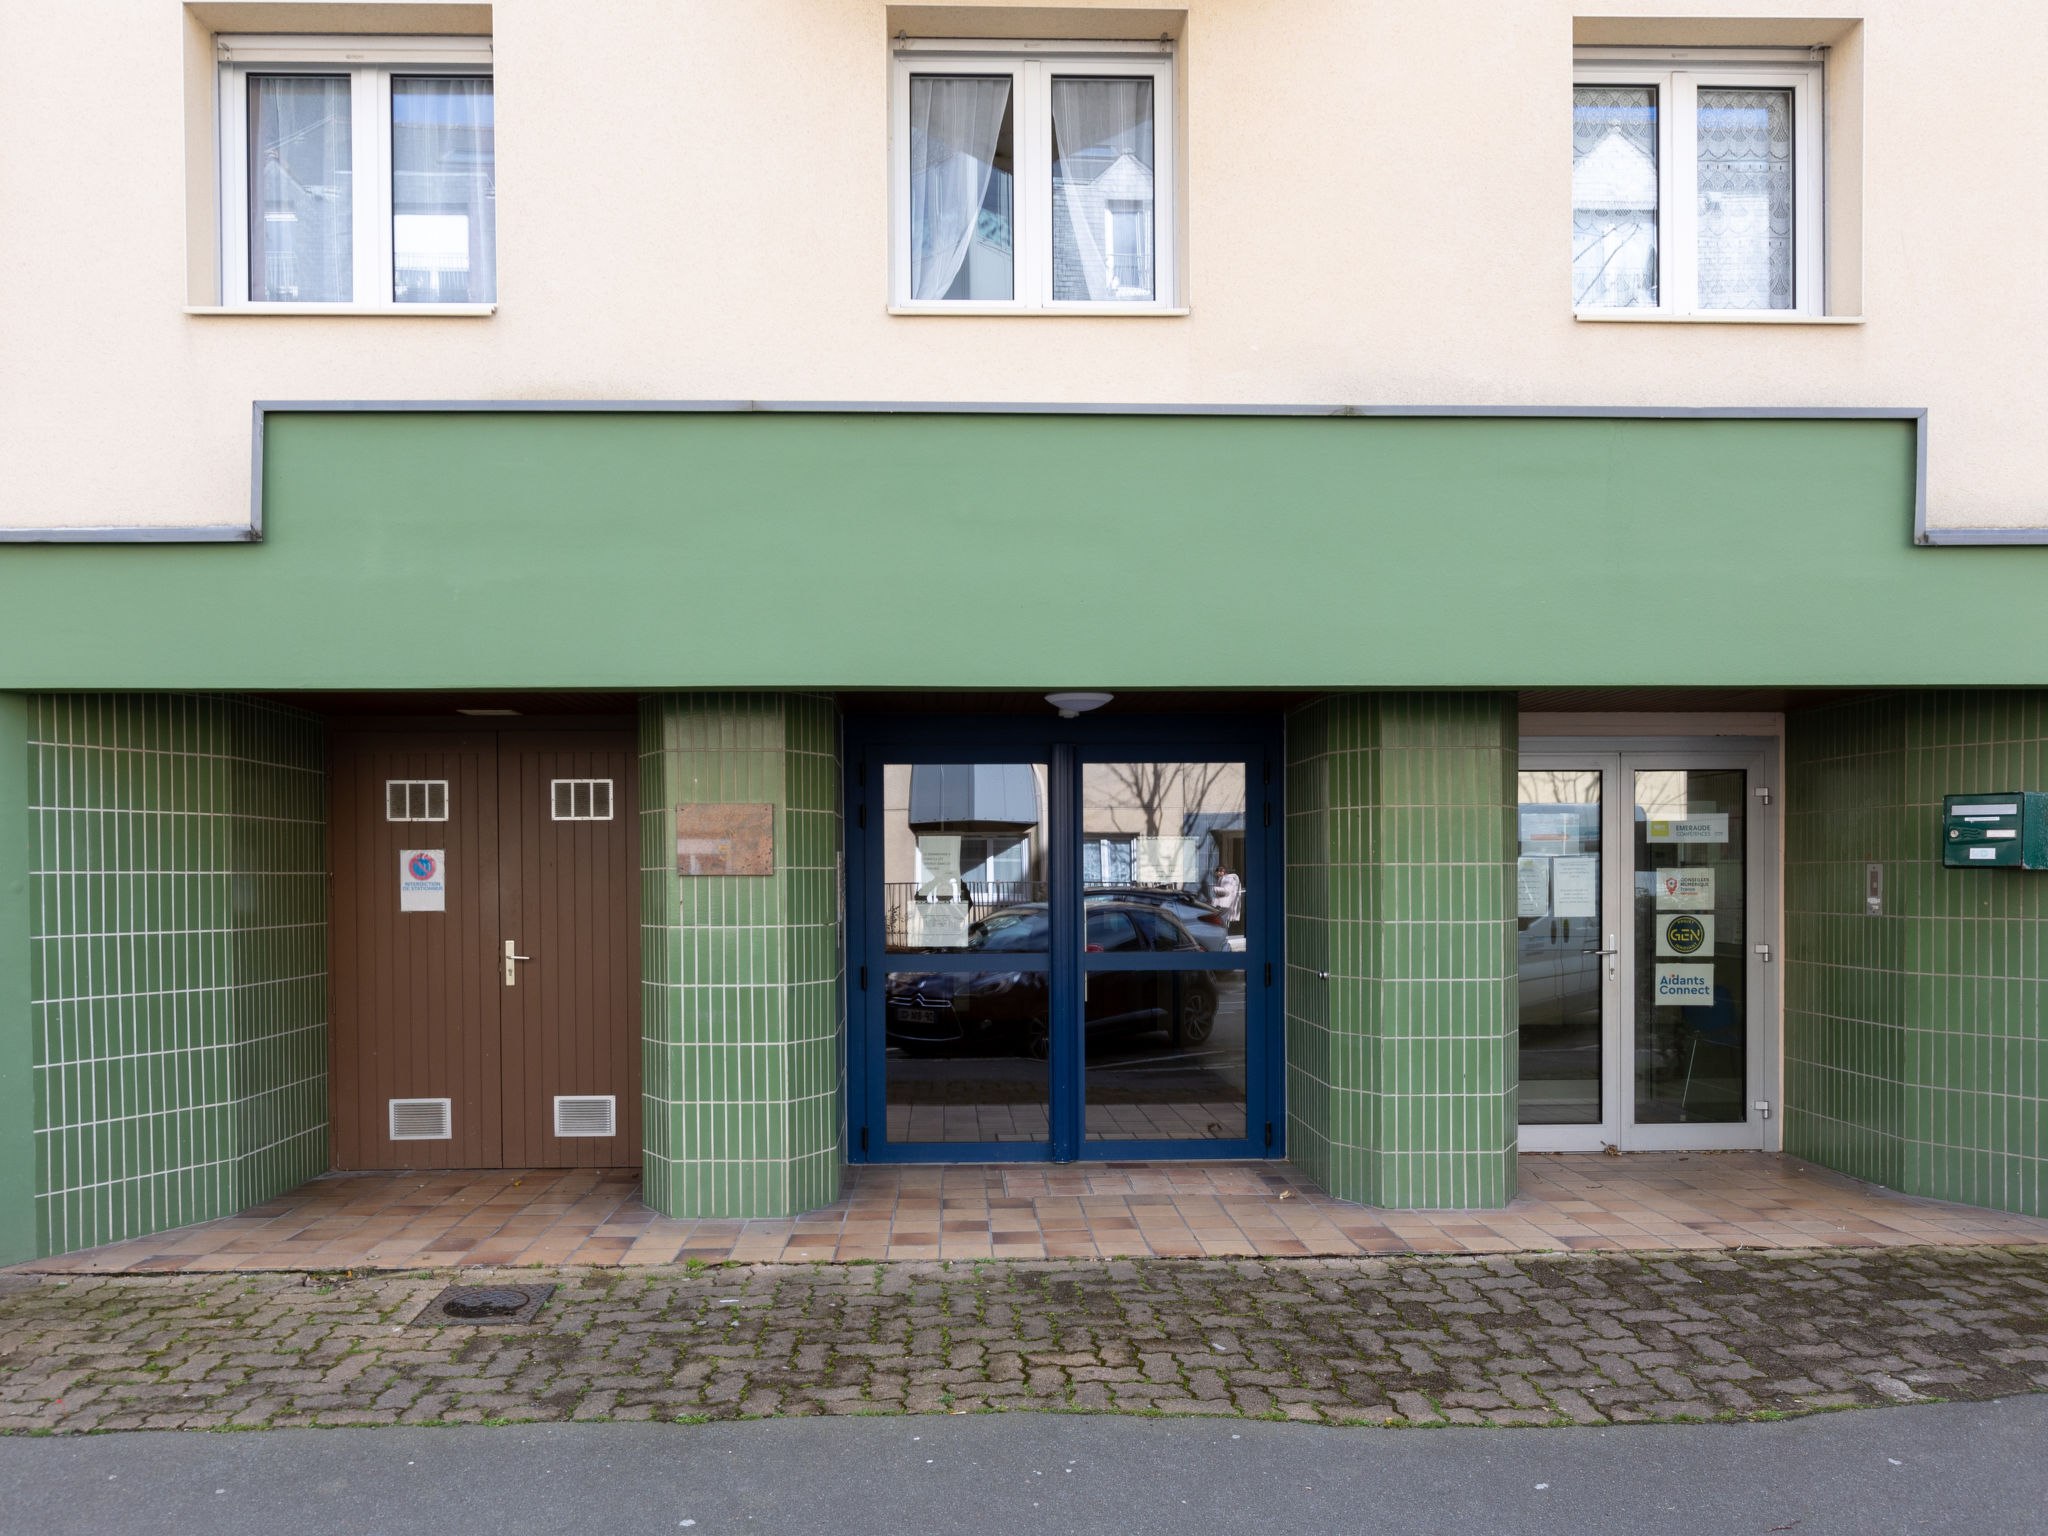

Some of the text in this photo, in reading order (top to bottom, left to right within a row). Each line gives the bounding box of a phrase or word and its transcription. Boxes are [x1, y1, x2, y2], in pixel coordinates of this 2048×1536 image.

[718, 844, 731, 861] 5
[1670, 928, 1700, 942] GEN
[1660, 973, 1705, 985] Aidants
[1659, 985, 1710, 995] Connect
